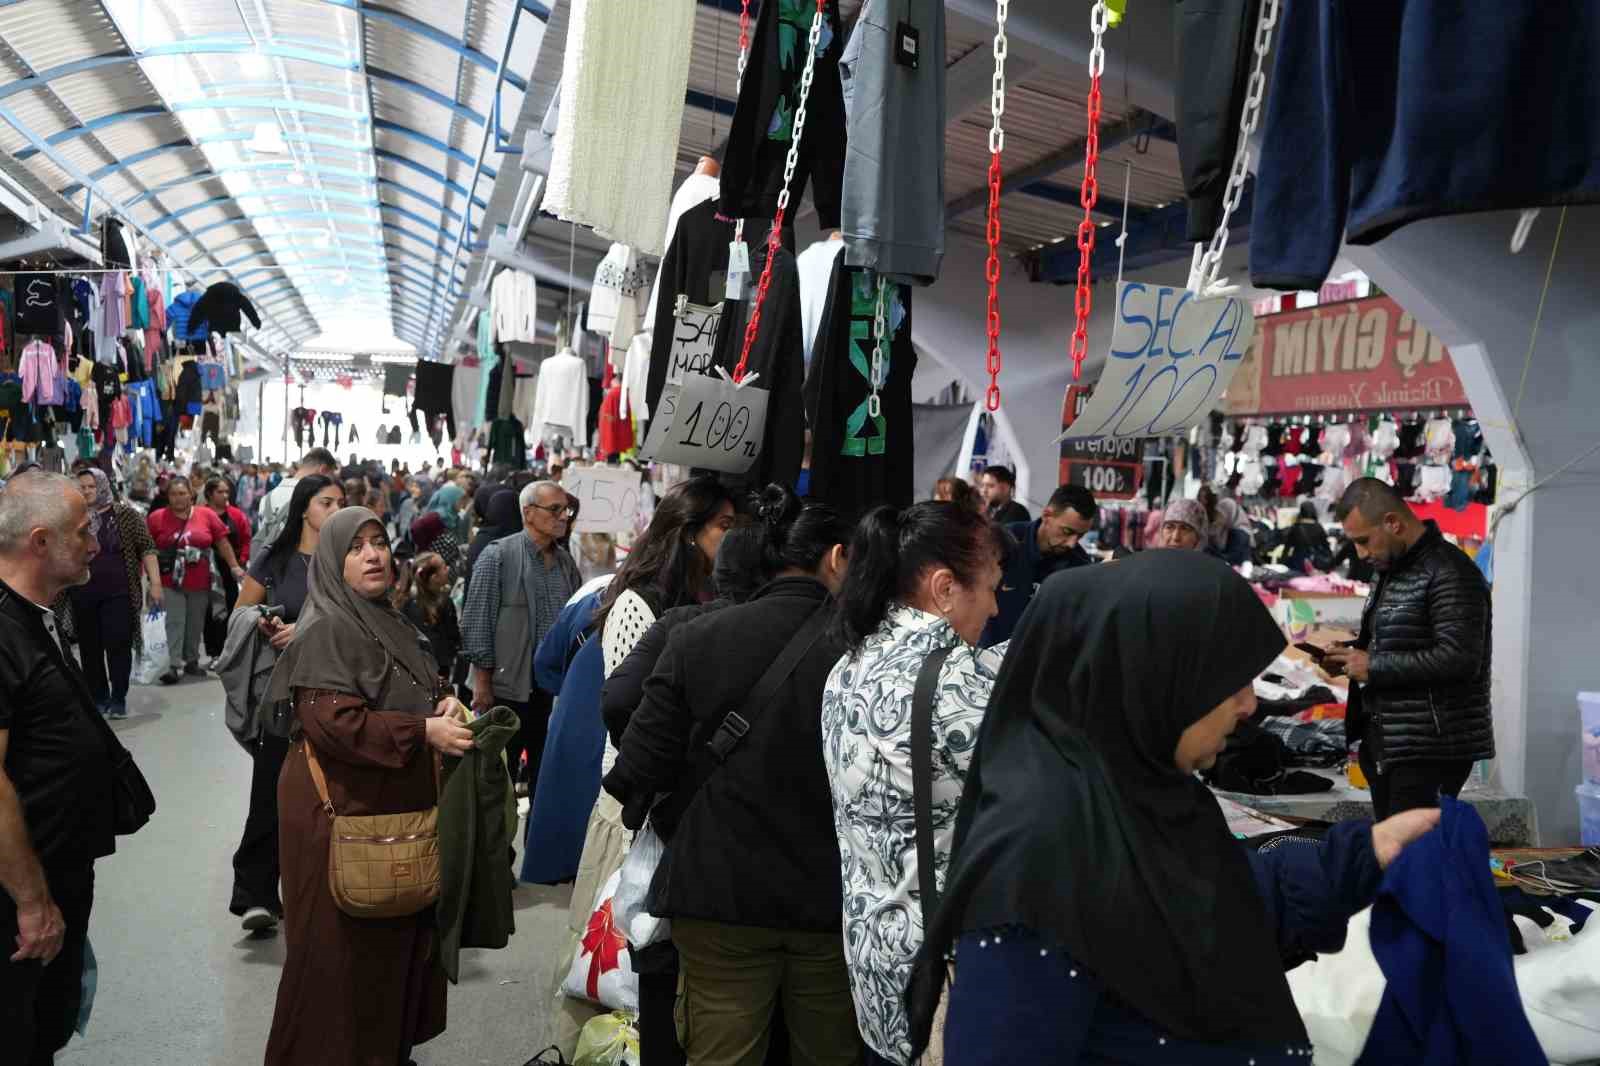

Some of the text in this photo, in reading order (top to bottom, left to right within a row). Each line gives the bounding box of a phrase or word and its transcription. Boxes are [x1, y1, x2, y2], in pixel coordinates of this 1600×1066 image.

[1111, 282, 1244, 366] SEÇ AL
[680, 401, 757, 457] 100 TL
[1090, 363, 1218, 438] 100
